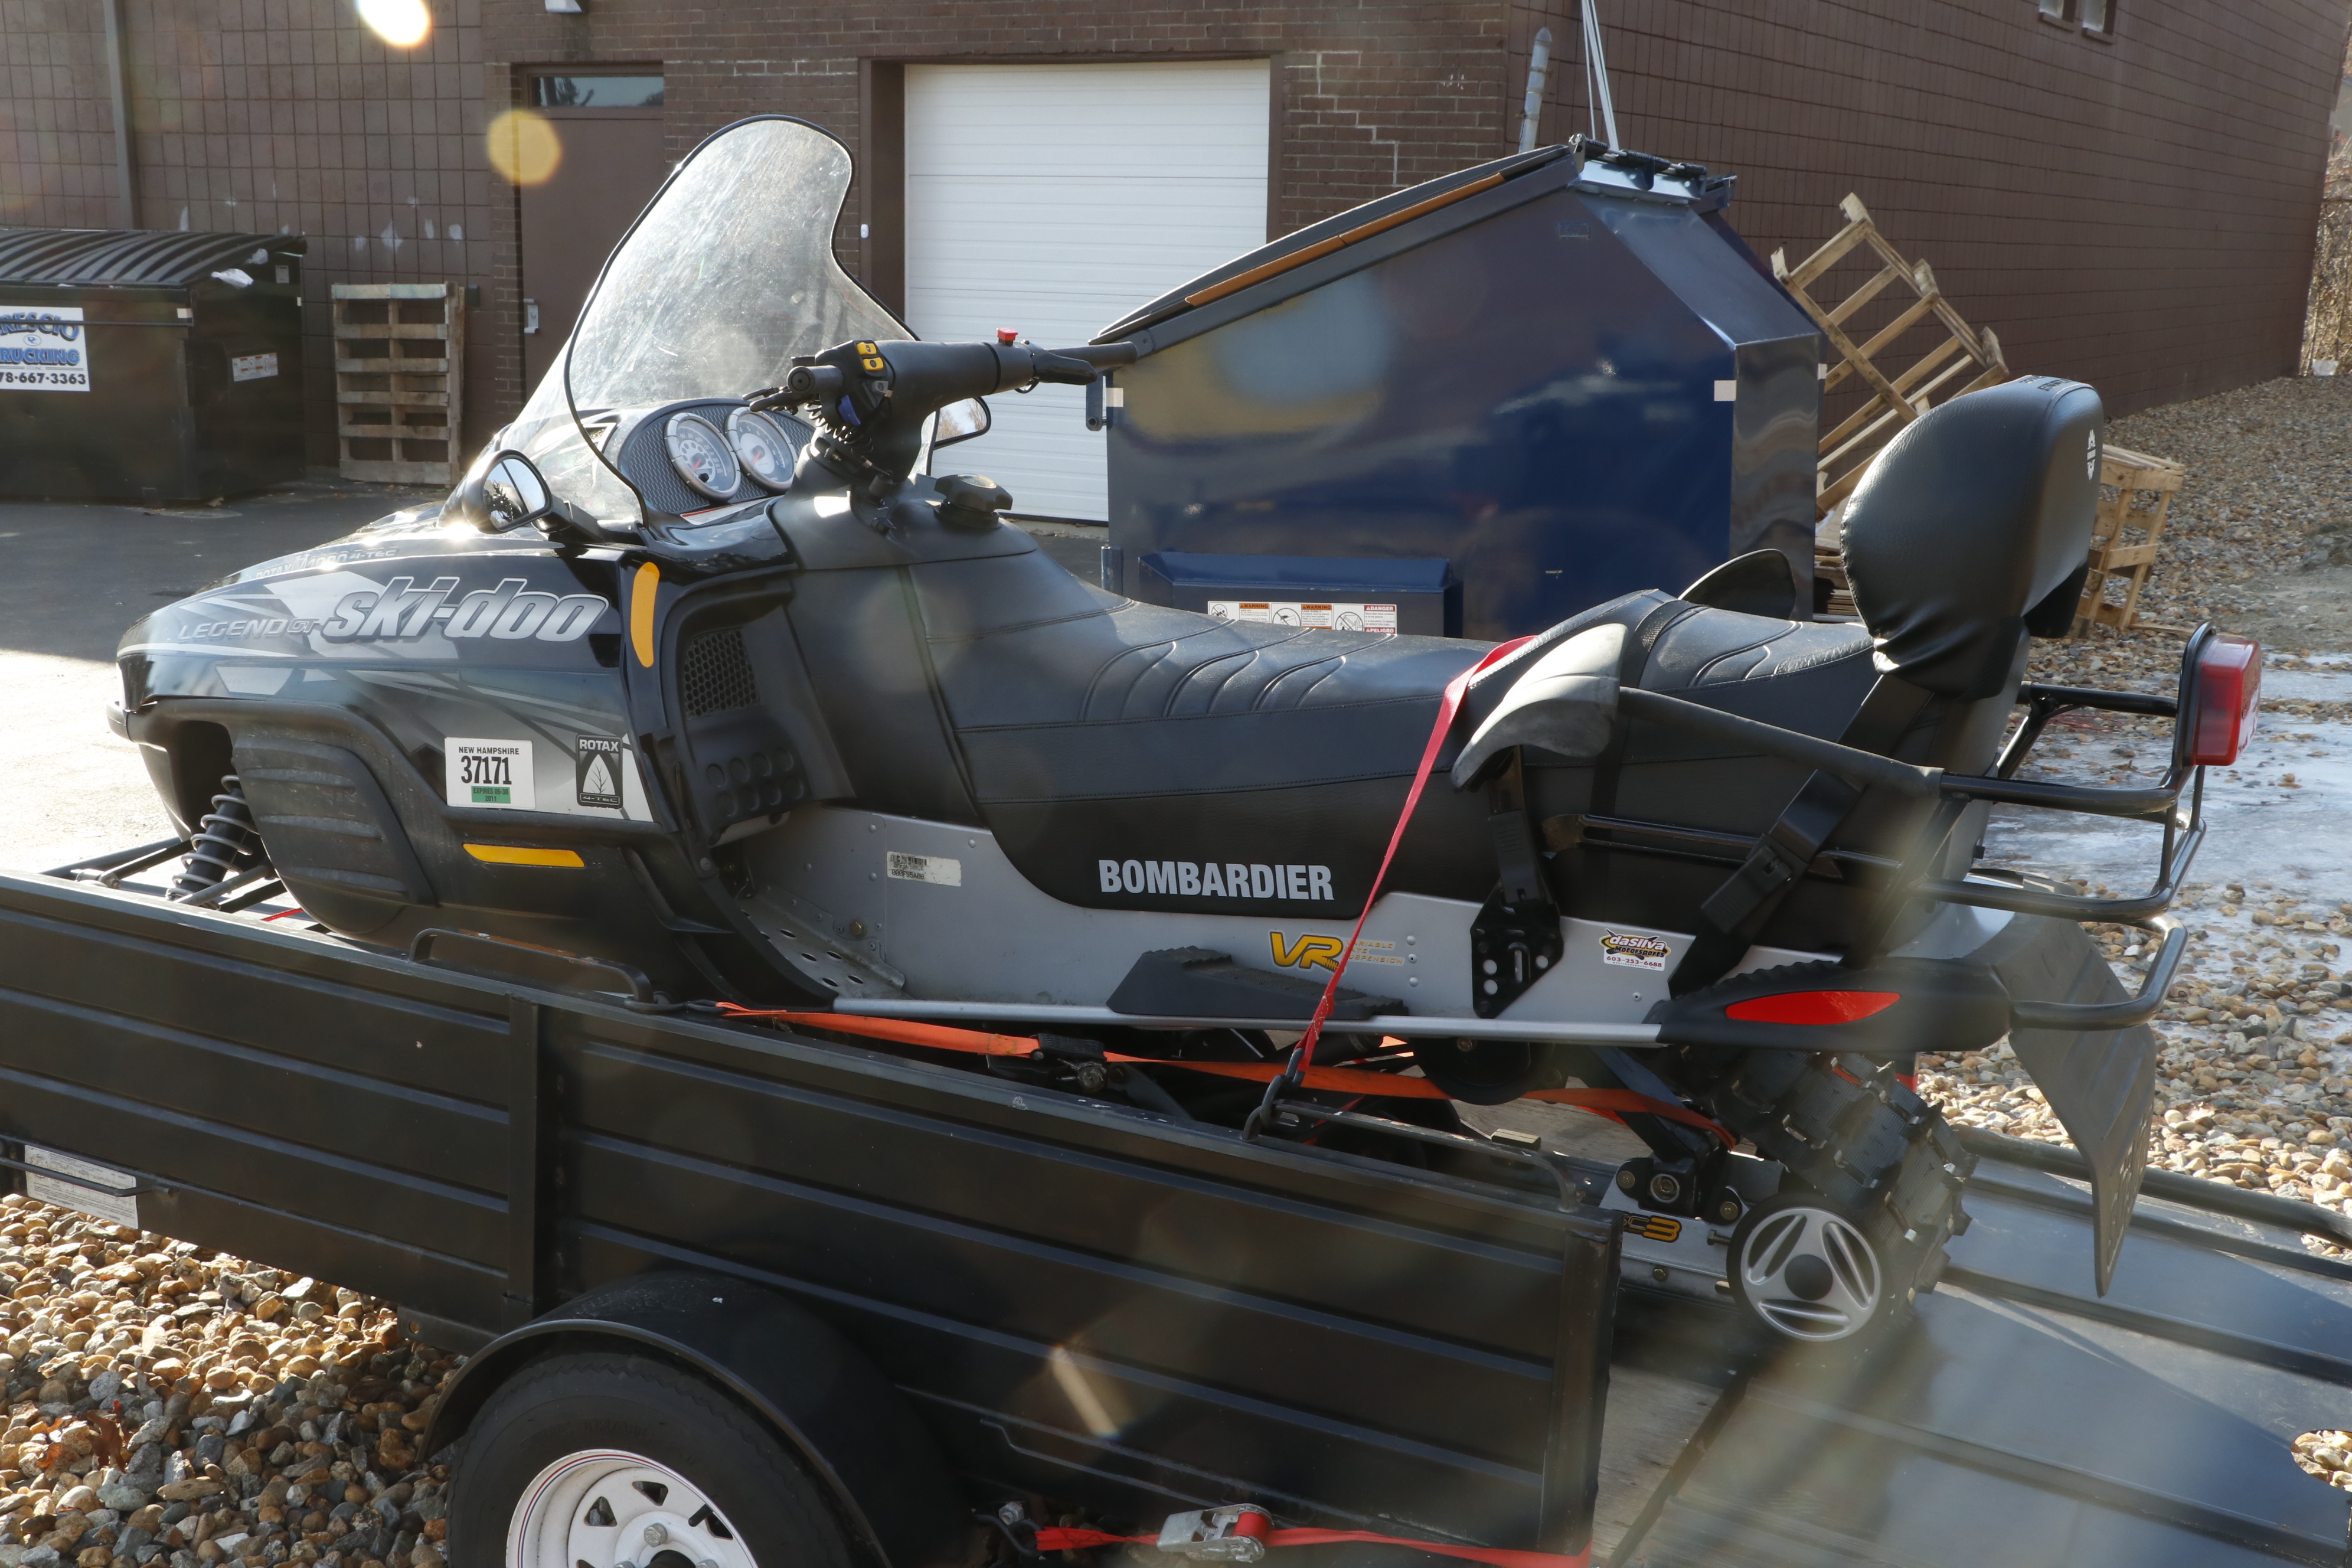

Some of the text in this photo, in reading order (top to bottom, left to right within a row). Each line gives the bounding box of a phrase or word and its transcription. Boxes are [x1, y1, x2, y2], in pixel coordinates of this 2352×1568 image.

[0, 312, 80, 341] RESCIO
[178, 619, 289, 642] LEGEND
[579, 739, 619, 752] ROTAX
[461, 755, 512, 785] 37171
[1099, 859, 1335, 900] BOMBARDIER
[1270, 932, 1344, 972] VR
[1344, 953, 1403, 963] USPENSION
[1607, 956, 1662, 968] 603-253-6688
[1615, 946, 1665, 957] Motorsports
